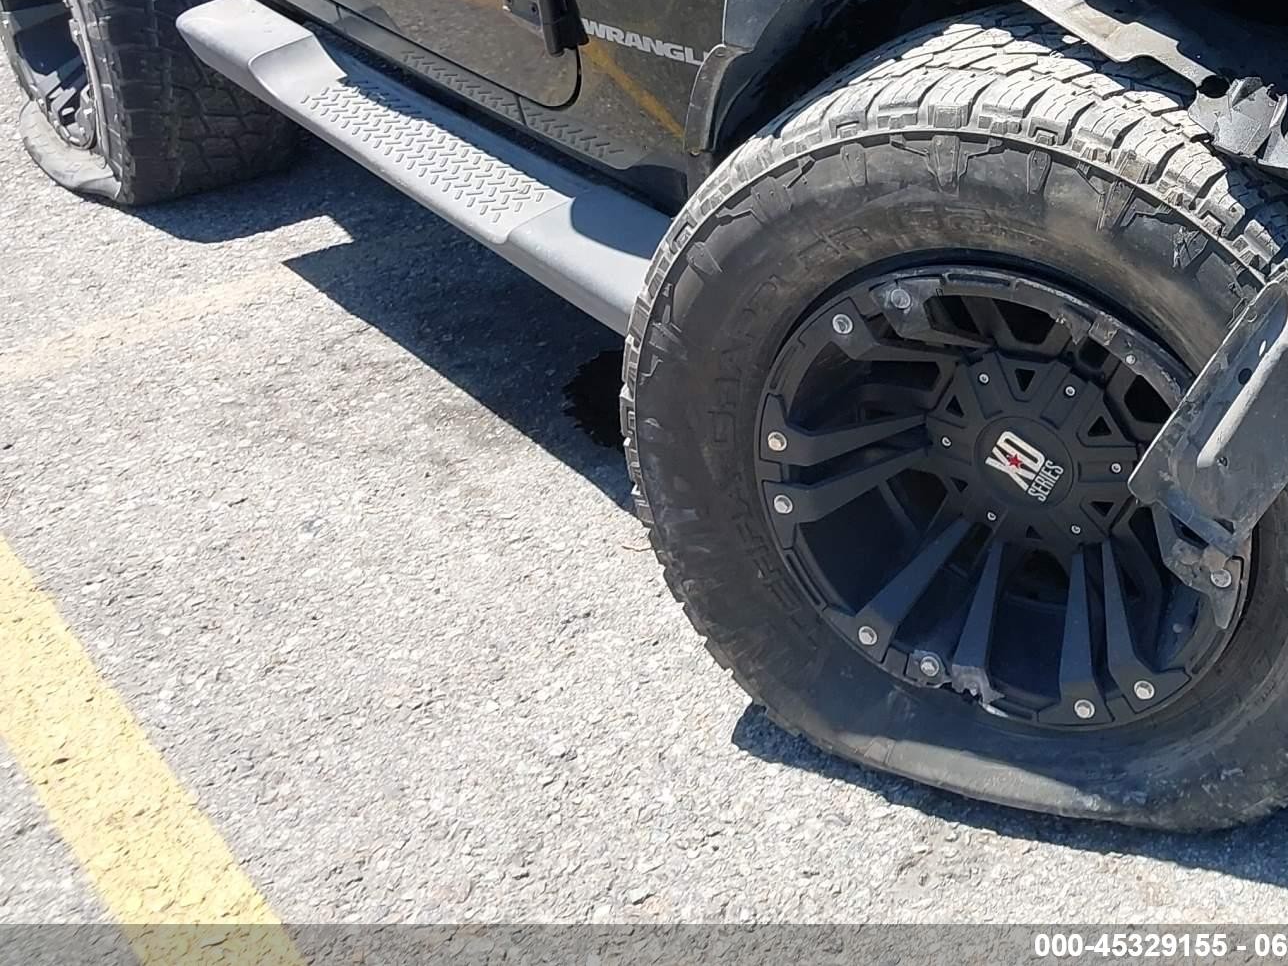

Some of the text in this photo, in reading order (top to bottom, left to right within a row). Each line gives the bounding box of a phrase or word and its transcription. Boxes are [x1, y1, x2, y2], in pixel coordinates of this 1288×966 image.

[580, 18, 708, 66] WRANGL
[985, 430, 1046, 492] XD
[1027, 459, 1065, 502] SERIES
